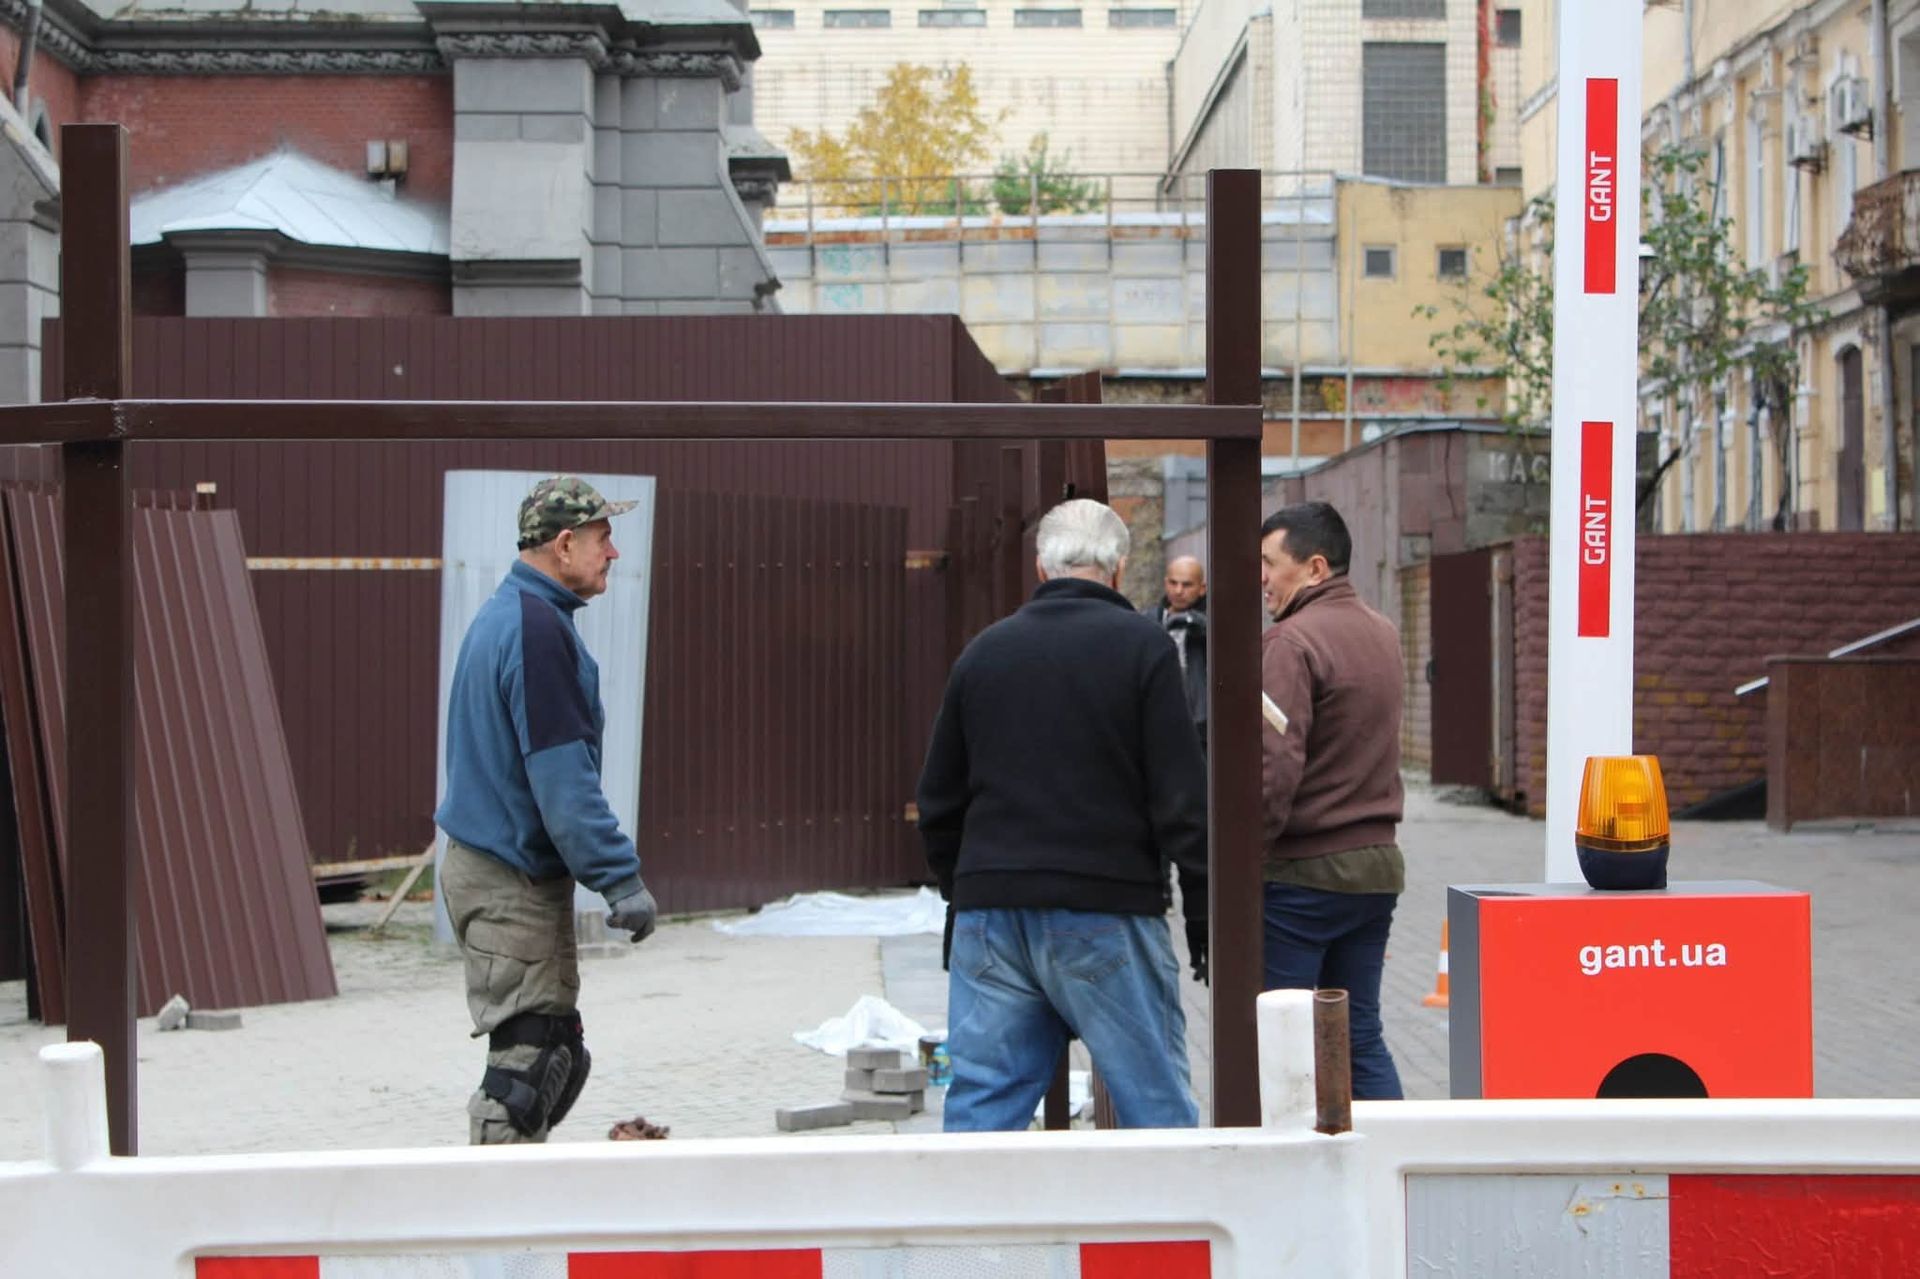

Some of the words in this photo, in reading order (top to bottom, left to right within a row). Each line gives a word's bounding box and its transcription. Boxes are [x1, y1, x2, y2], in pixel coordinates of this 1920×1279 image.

[1590, 151, 1611, 221] GANT
[1584, 494, 1606, 564] GANT
[1579, 939, 1726, 975] gant.ua
